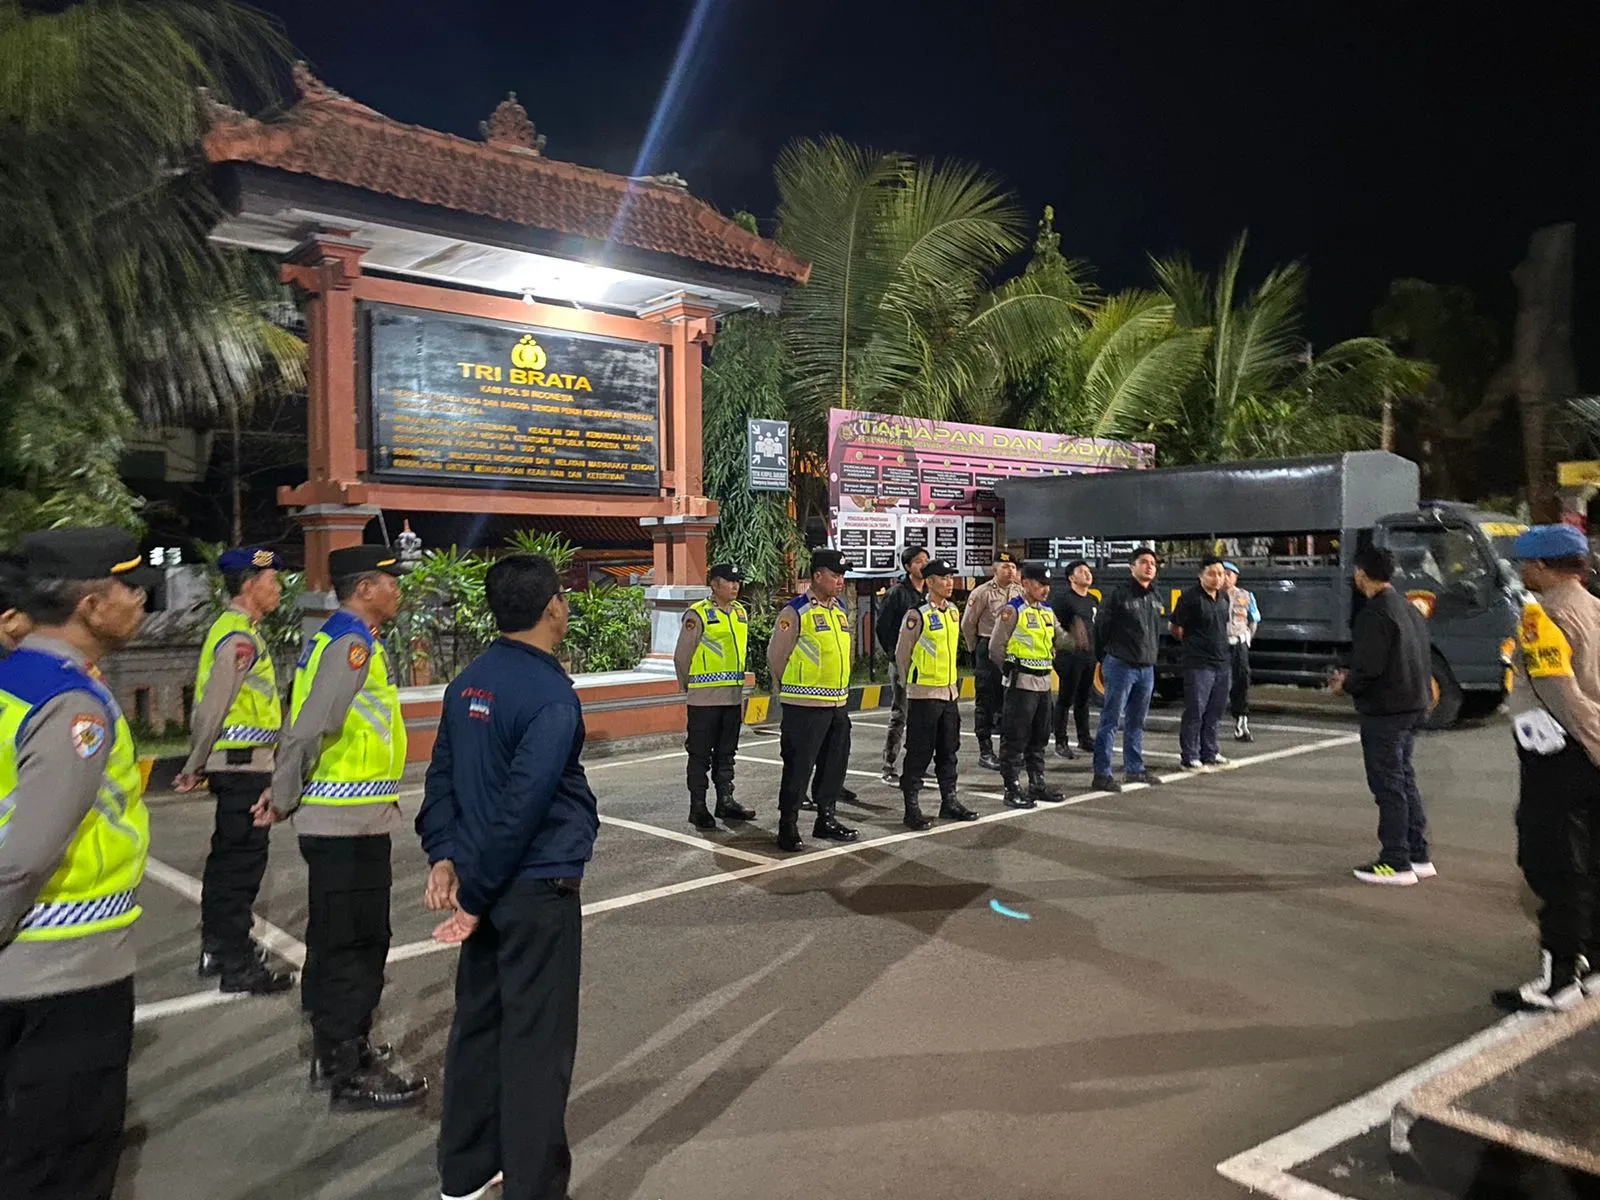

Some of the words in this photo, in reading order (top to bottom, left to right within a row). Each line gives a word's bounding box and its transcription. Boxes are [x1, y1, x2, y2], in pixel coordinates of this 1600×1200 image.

[457, 362, 502, 382] TRI
[509, 368, 593, 392] BRATA
[530, 390, 575, 402] INDONESIA
[859, 419, 986, 447] TAHAPAN
[992, 433, 1042, 451] DAN
[1049, 442, 1138, 460] JADWAL
